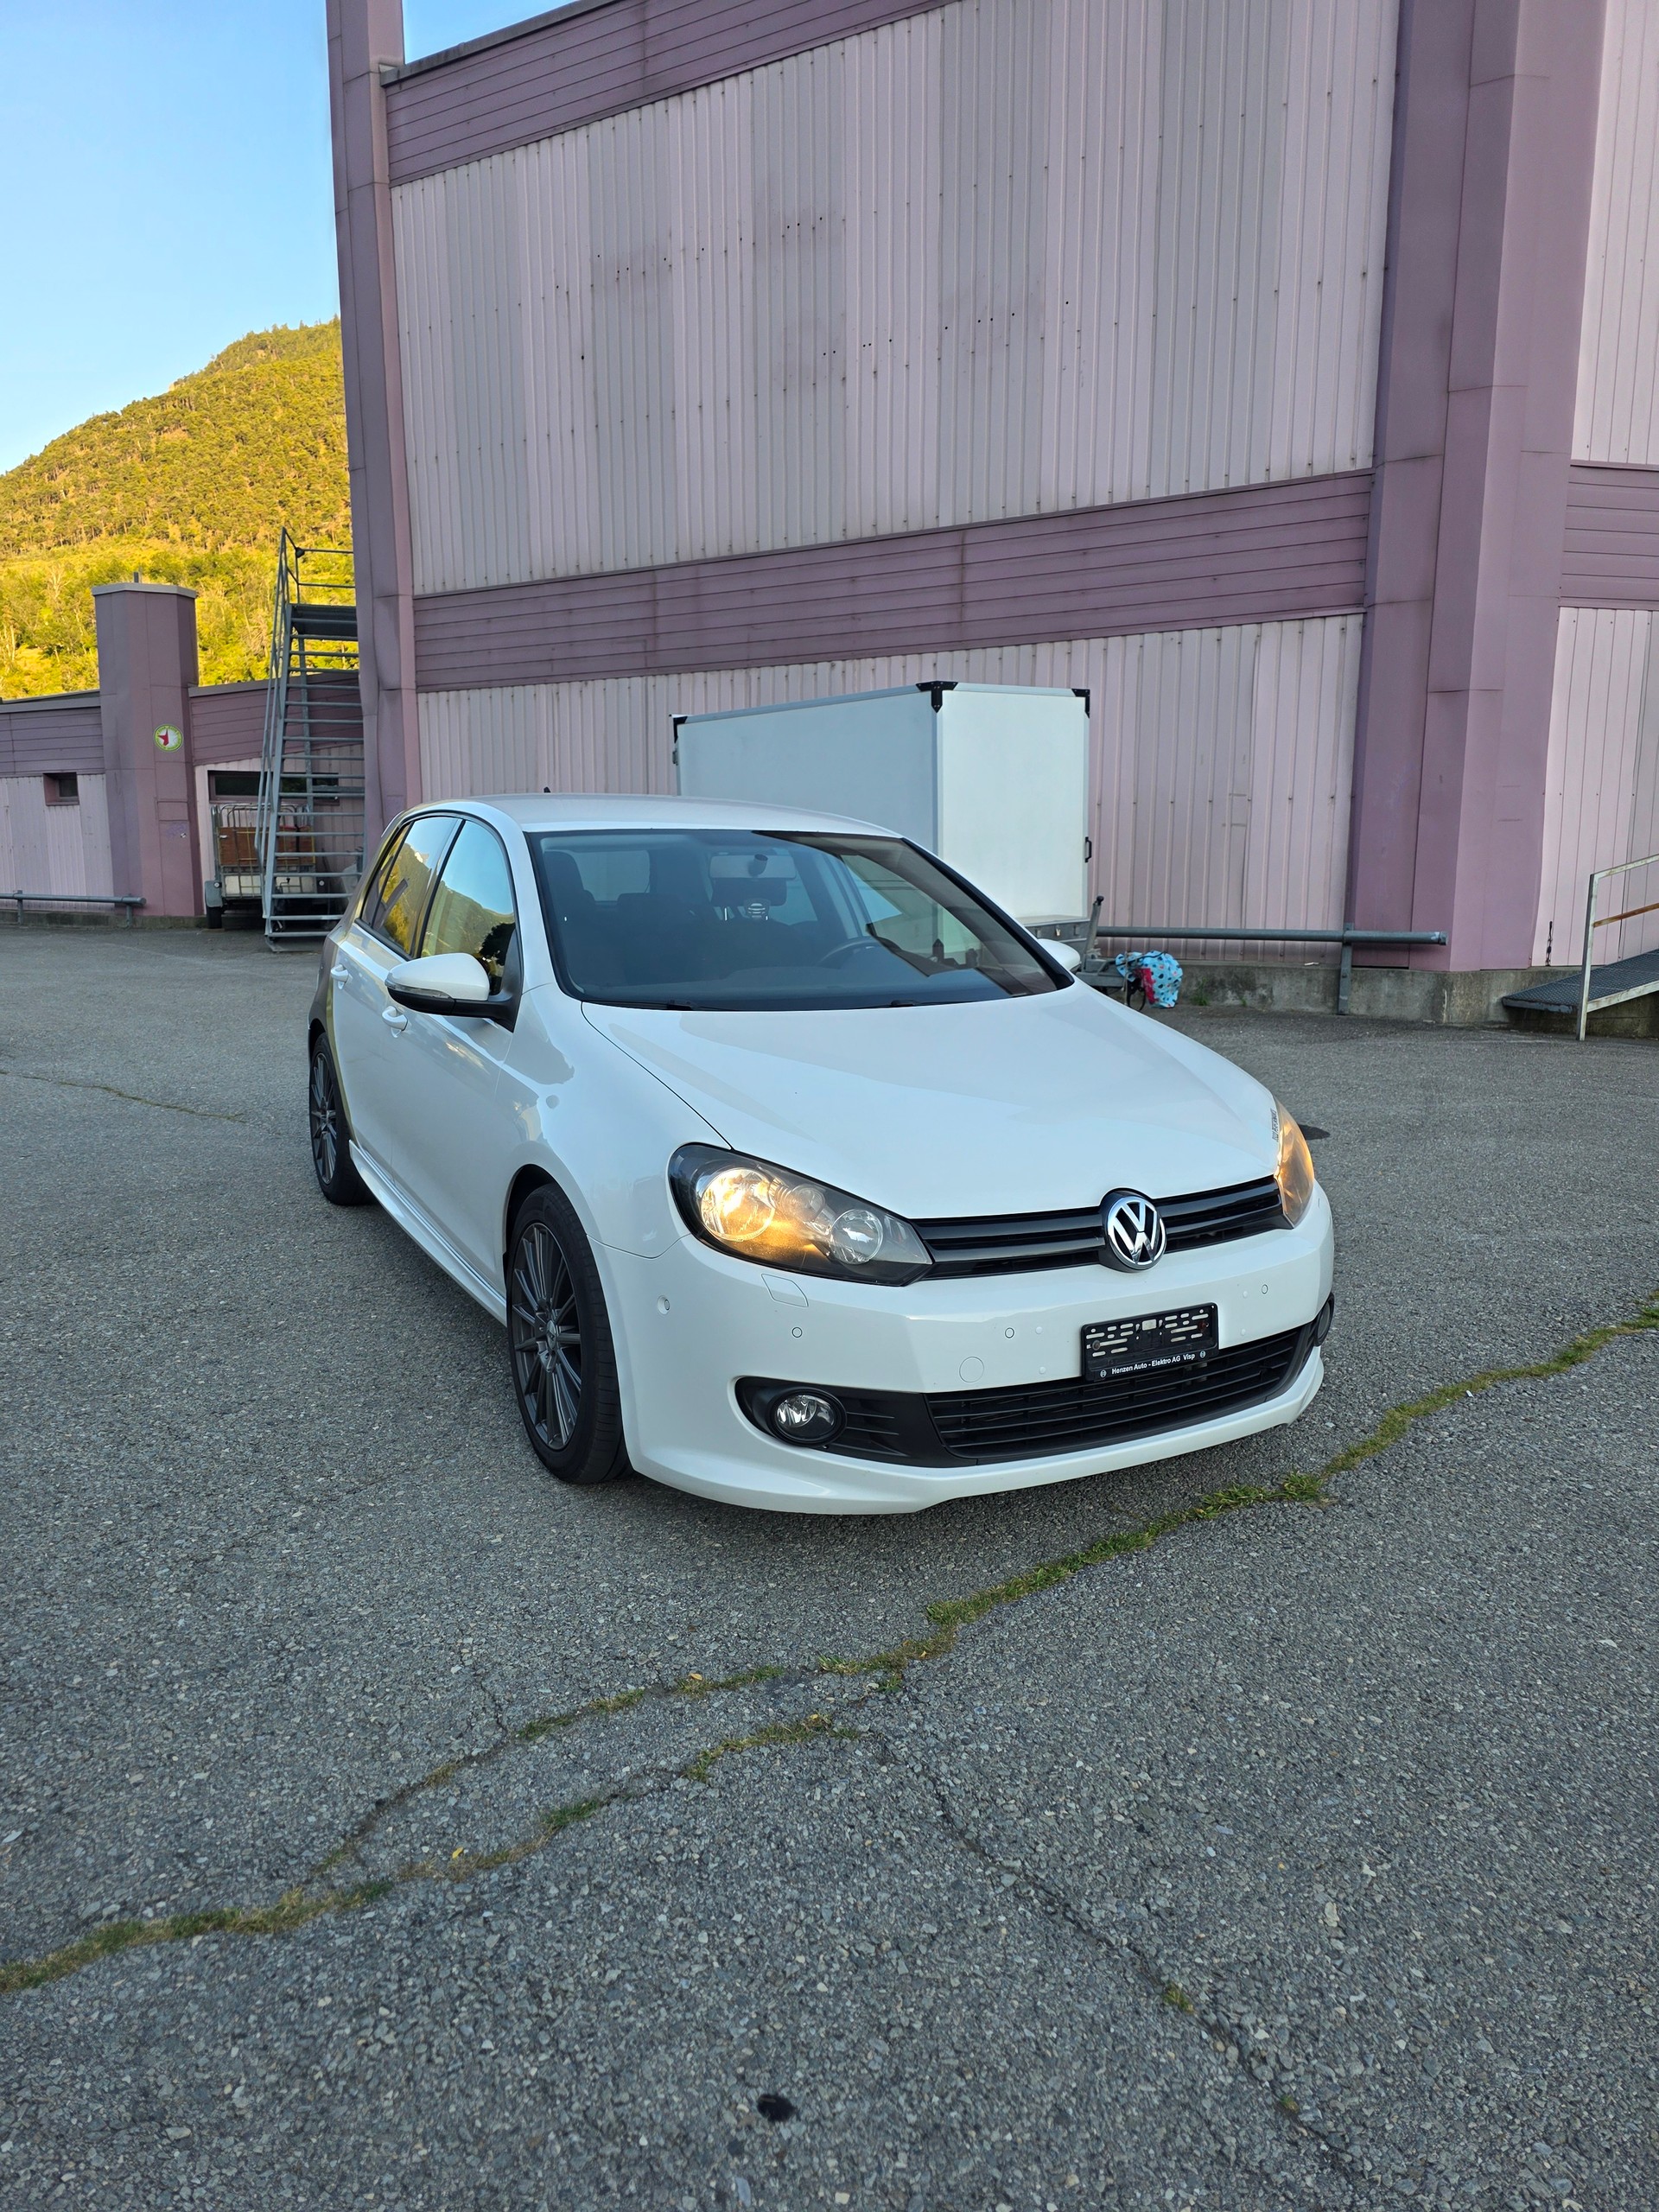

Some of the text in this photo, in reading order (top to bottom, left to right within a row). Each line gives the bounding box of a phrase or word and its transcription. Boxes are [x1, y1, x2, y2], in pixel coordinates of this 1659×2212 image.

[1108, 1198, 1164, 1267] VW
[1111, 1365, 1133, 1375] Henzen
[1152, 1357, 1172, 1367] Elektro
